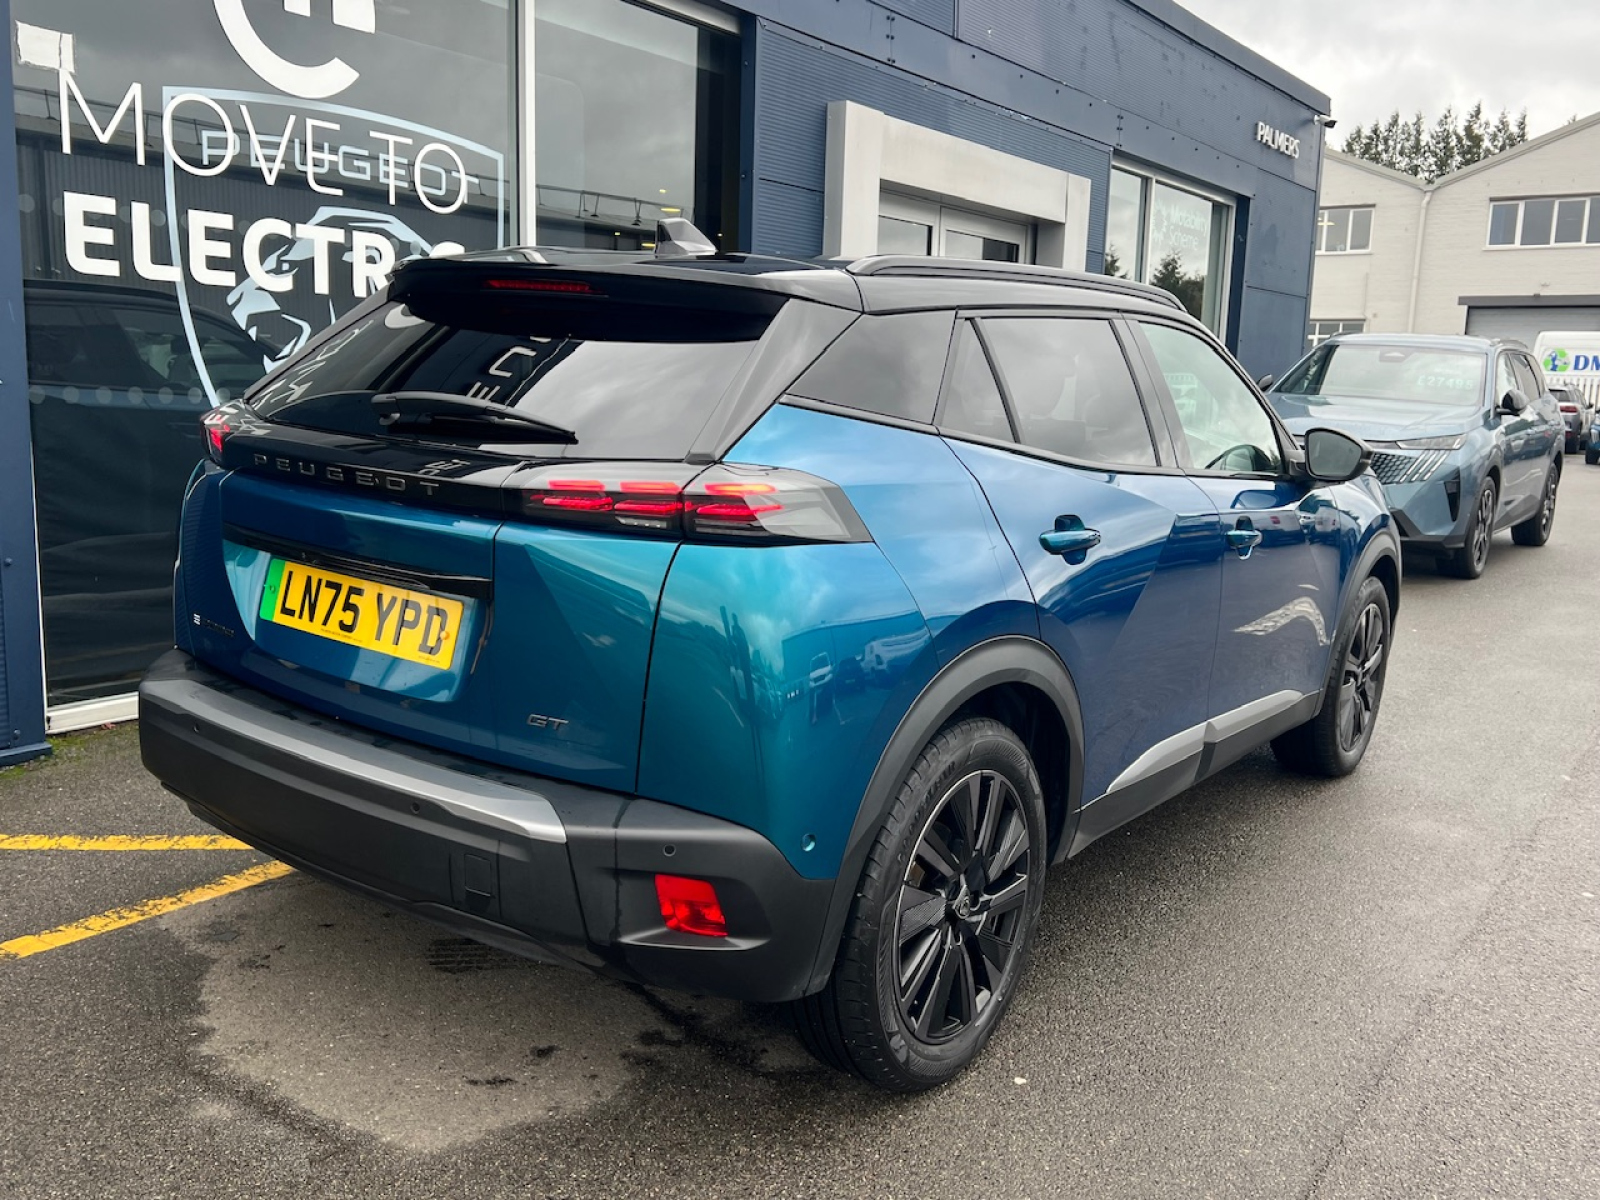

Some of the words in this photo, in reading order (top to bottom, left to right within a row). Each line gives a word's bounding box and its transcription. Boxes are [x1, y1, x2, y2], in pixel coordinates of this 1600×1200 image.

[59, 68, 344, 196] MOVE
[370, 130, 467, 214] TO
[201, 130, 479, 204] PEUGEOT
[1256, 121, 1300, 159] PALMERS
[63, 191, 465, 298] ELECTR
[253, 453, 440, 496] PEUGEOT
[279, 570, 365, 633] LN75
[374, 591, 449, 656] YPD
[527, 713, 570, 731] GT
